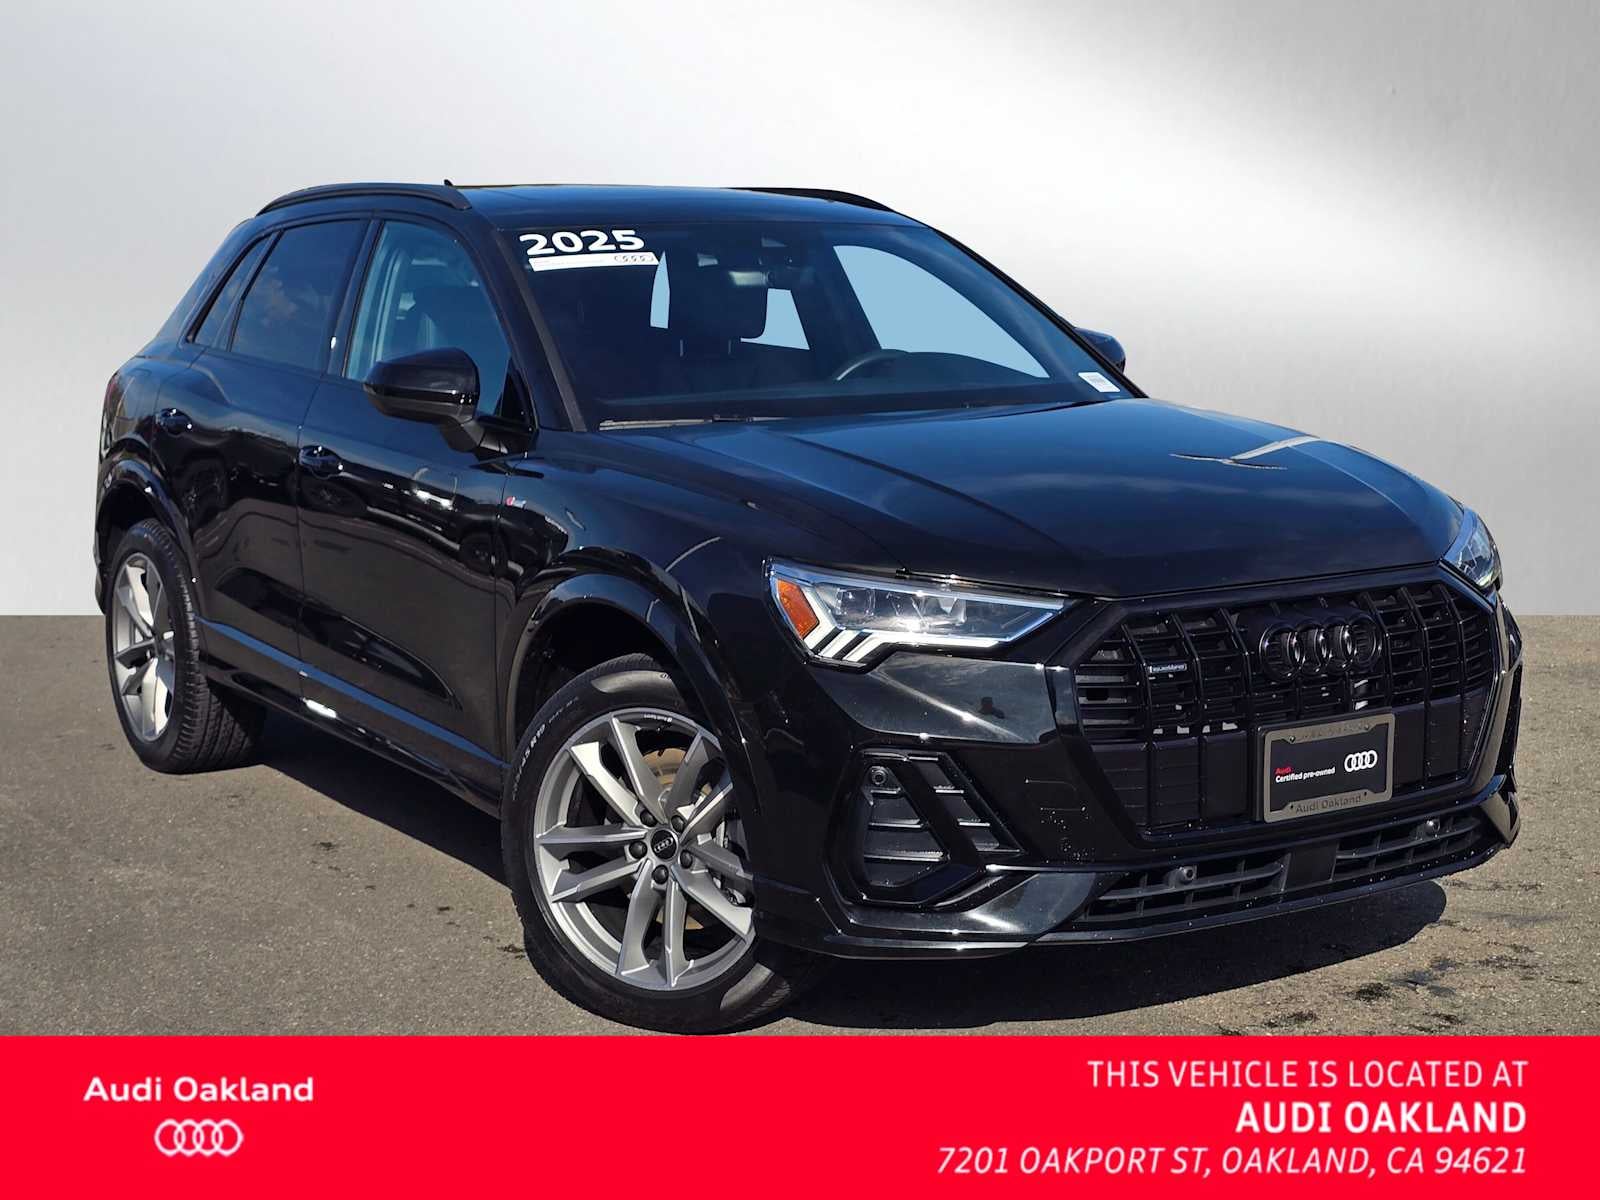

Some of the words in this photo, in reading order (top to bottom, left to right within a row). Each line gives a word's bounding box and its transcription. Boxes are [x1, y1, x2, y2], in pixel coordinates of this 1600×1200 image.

[519, 229, 645, 256] 2025
[1275, 766, 1292, 775] Audi
[1275, 771, 1303, 783] Certified
[1303, 766, 1336, 780] pre-owned
[1296, 800, 1319, 814] Audi
[1321, 794, 1362, 809] Oakland
